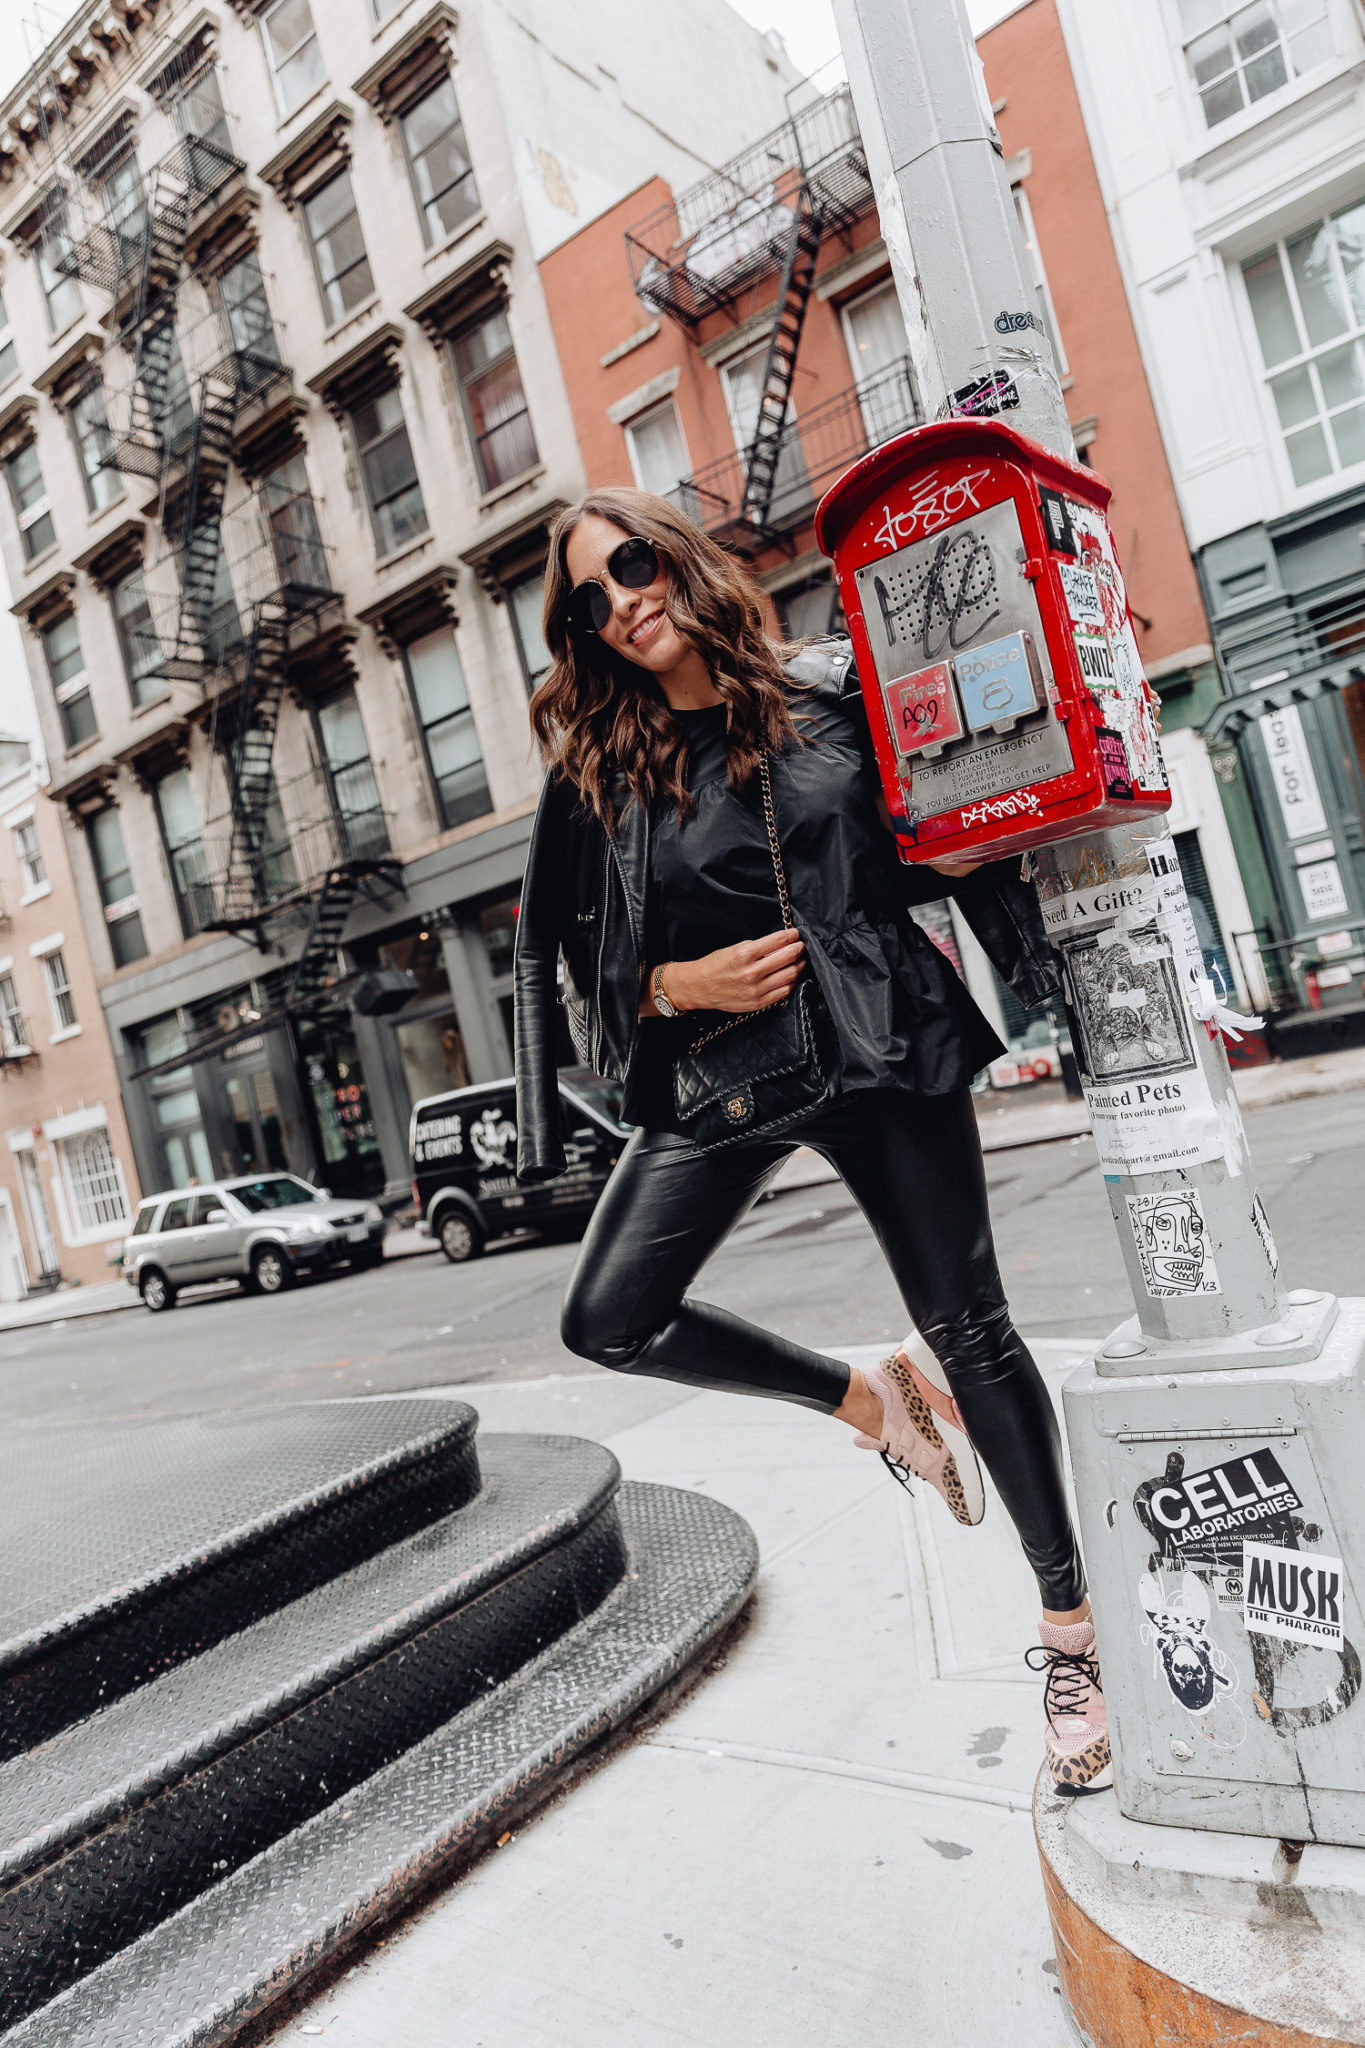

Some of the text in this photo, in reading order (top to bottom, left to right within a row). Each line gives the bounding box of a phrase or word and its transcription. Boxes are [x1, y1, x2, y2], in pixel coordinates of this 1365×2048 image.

[959, 648, 1021, 683] Police
[1078, 645, 1113, 679] BWIZ
[899, 682, 937, 707] Fire
[918, 732, 1044, 781] TO REPORT AN EMERGENCY
[972, 761, 993, 772] COVER
[925, 763, 1051, 808] YOU MUST ANSWER TO GET HELP
[957, 774, 974, 783] PUSH
[975, 764, 1001, 777] BUTTON
[960, 777, 985, 789] ANSWER
[1072, 901, 1088, 917] A
[1094, 887, 1143, 913] Gift?
[1087, 1083, 1182, 1109] Painted Pets
[1120, 1109, 1156, 1120] favorite
[1150, 1458, 1290, 1529] CELL
[1170, 1493, 1299, 1547] LABORATORIES
[1230, 1533, 1259, 1541] EXCLUSIVE
[1260, 1532, 1275, 1540] CLUB
[1247, 1556, 1340, 1624] MUSK
[1247, 1609, 1341, 1639] THE PHARAOH
